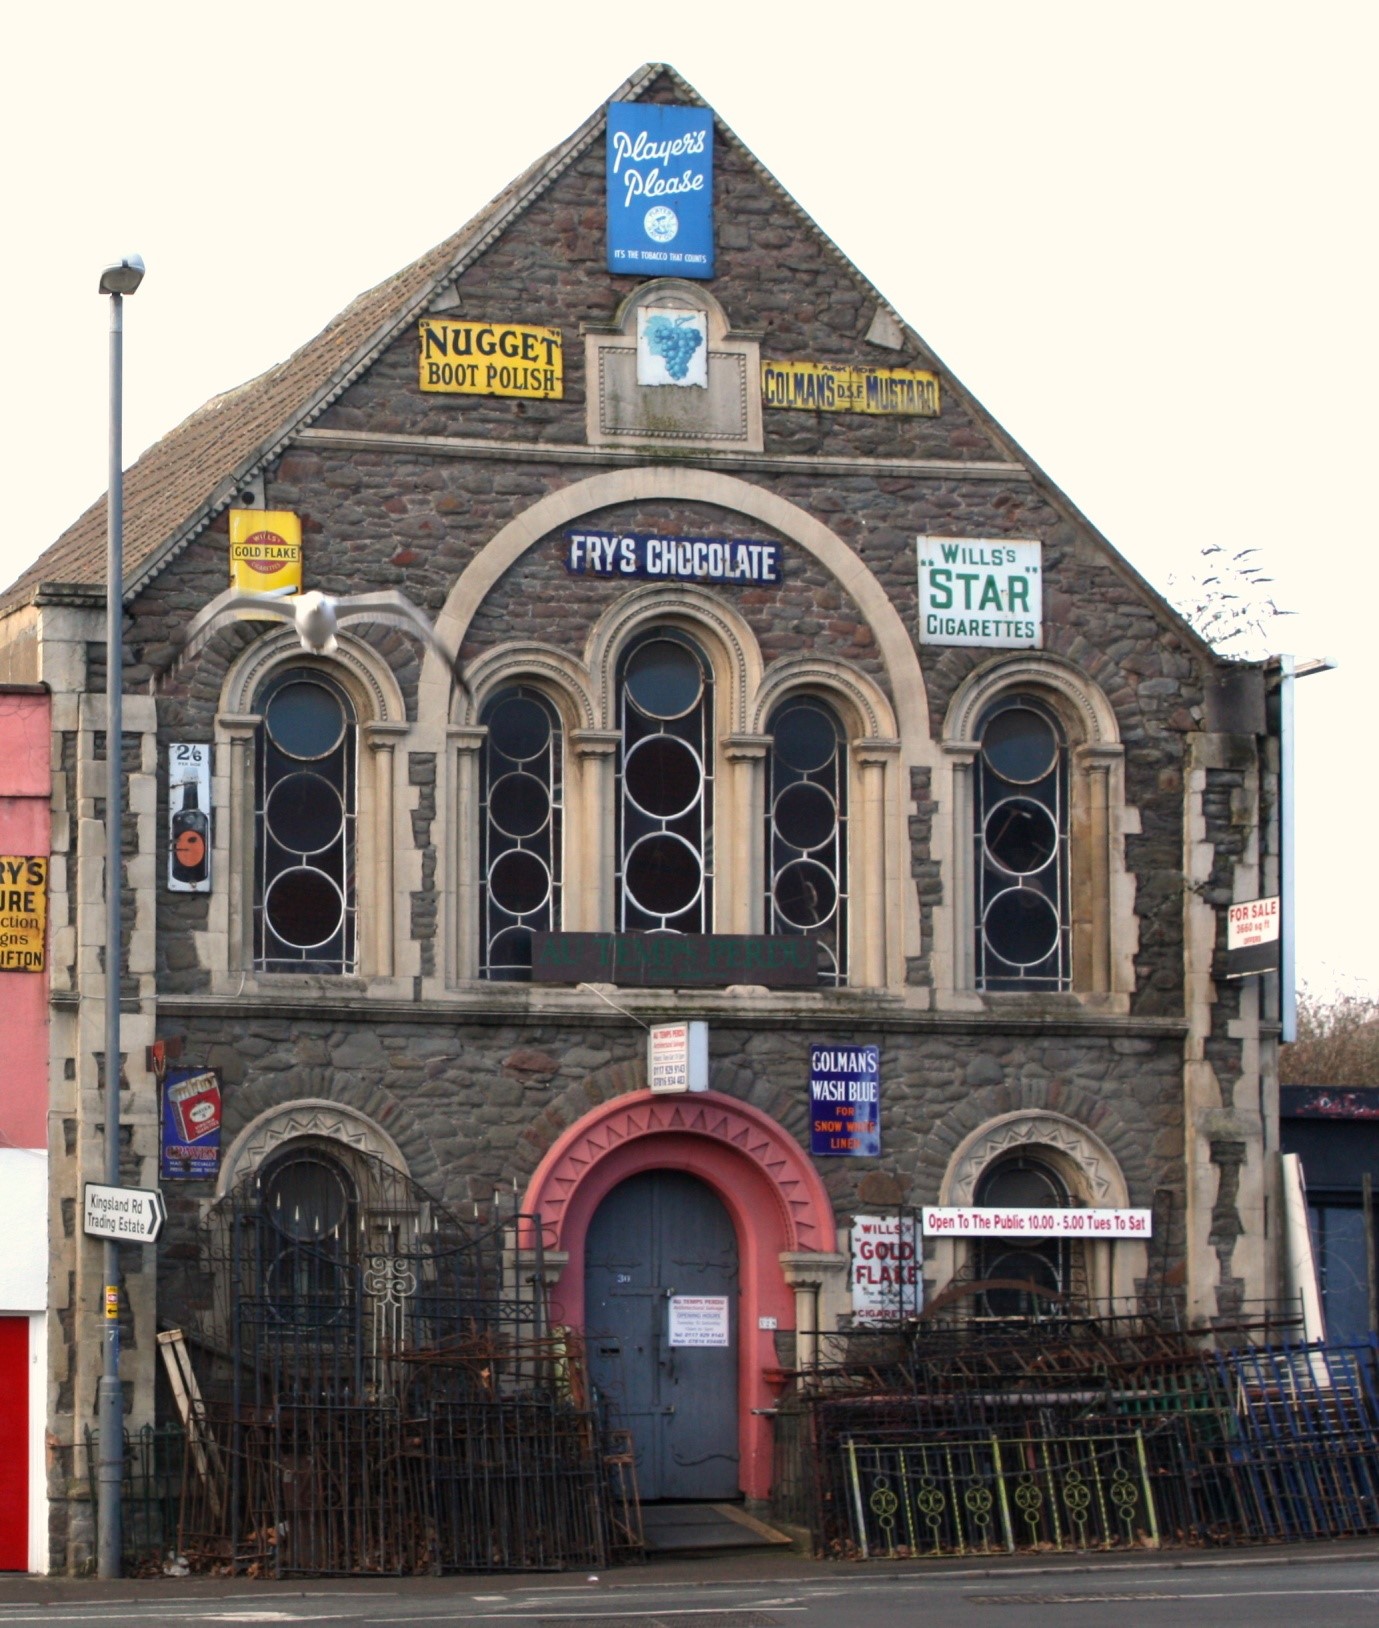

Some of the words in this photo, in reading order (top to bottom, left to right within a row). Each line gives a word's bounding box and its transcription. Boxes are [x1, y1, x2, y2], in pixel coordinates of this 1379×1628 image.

[613, 130, 706, 173] Player's
[624, 168, 704, 207] Please
[627, 250, 639, 259] THE
[641, 251, 668, 261] TOBACCO
[669, 252, 683, 262] THAT
[684, 253, 707, 264] COUNTS
[428, 362, 478, 387] BOOT
[486, 364, 555, 391] POLISH
[865, 375, 935, 412] MUSTARD
[235, 546, 261, 557] GOLD
[264, 547, 297, 559] FLAKE
[647, 539, 776, 580] CHOCOLATE
[927, 614, 1035, 638] CIGARETTES
[177, 744, 202, 762] 2/6
[1230, 906, 1249, 922] FOR
[1252, 901, 1276, 918] SALE
[812, 1080, 845, 1101] WASH
[849, 1081, 877, 1102] BLUE
[836, 1106, 855, 1117] FOR
[815, 1121, 842, 1132] SNOW
[91, 1194, 129, 1212] Kingsland
[132, 1199, 143, 1214] Rd
[88, 1212, 116, 1232] Trading
[119, 1216, 145, 1235] Estate
[929, 1214, 954, 1231] Open
[958, 1214, 970, 1228] To
[972, 1214, 990, 1229] The
[994, 1214, 1025, 1229] Public
[1029, 1215, 1054, 1229] 10.00
[1063, 1216, 1084, 1229] 5.00
[1087, 1215, 1111, 1230] Tues
[1115, 1215, 1126, 1230] To
[1128, 1216, 1146, 1231] Sat
